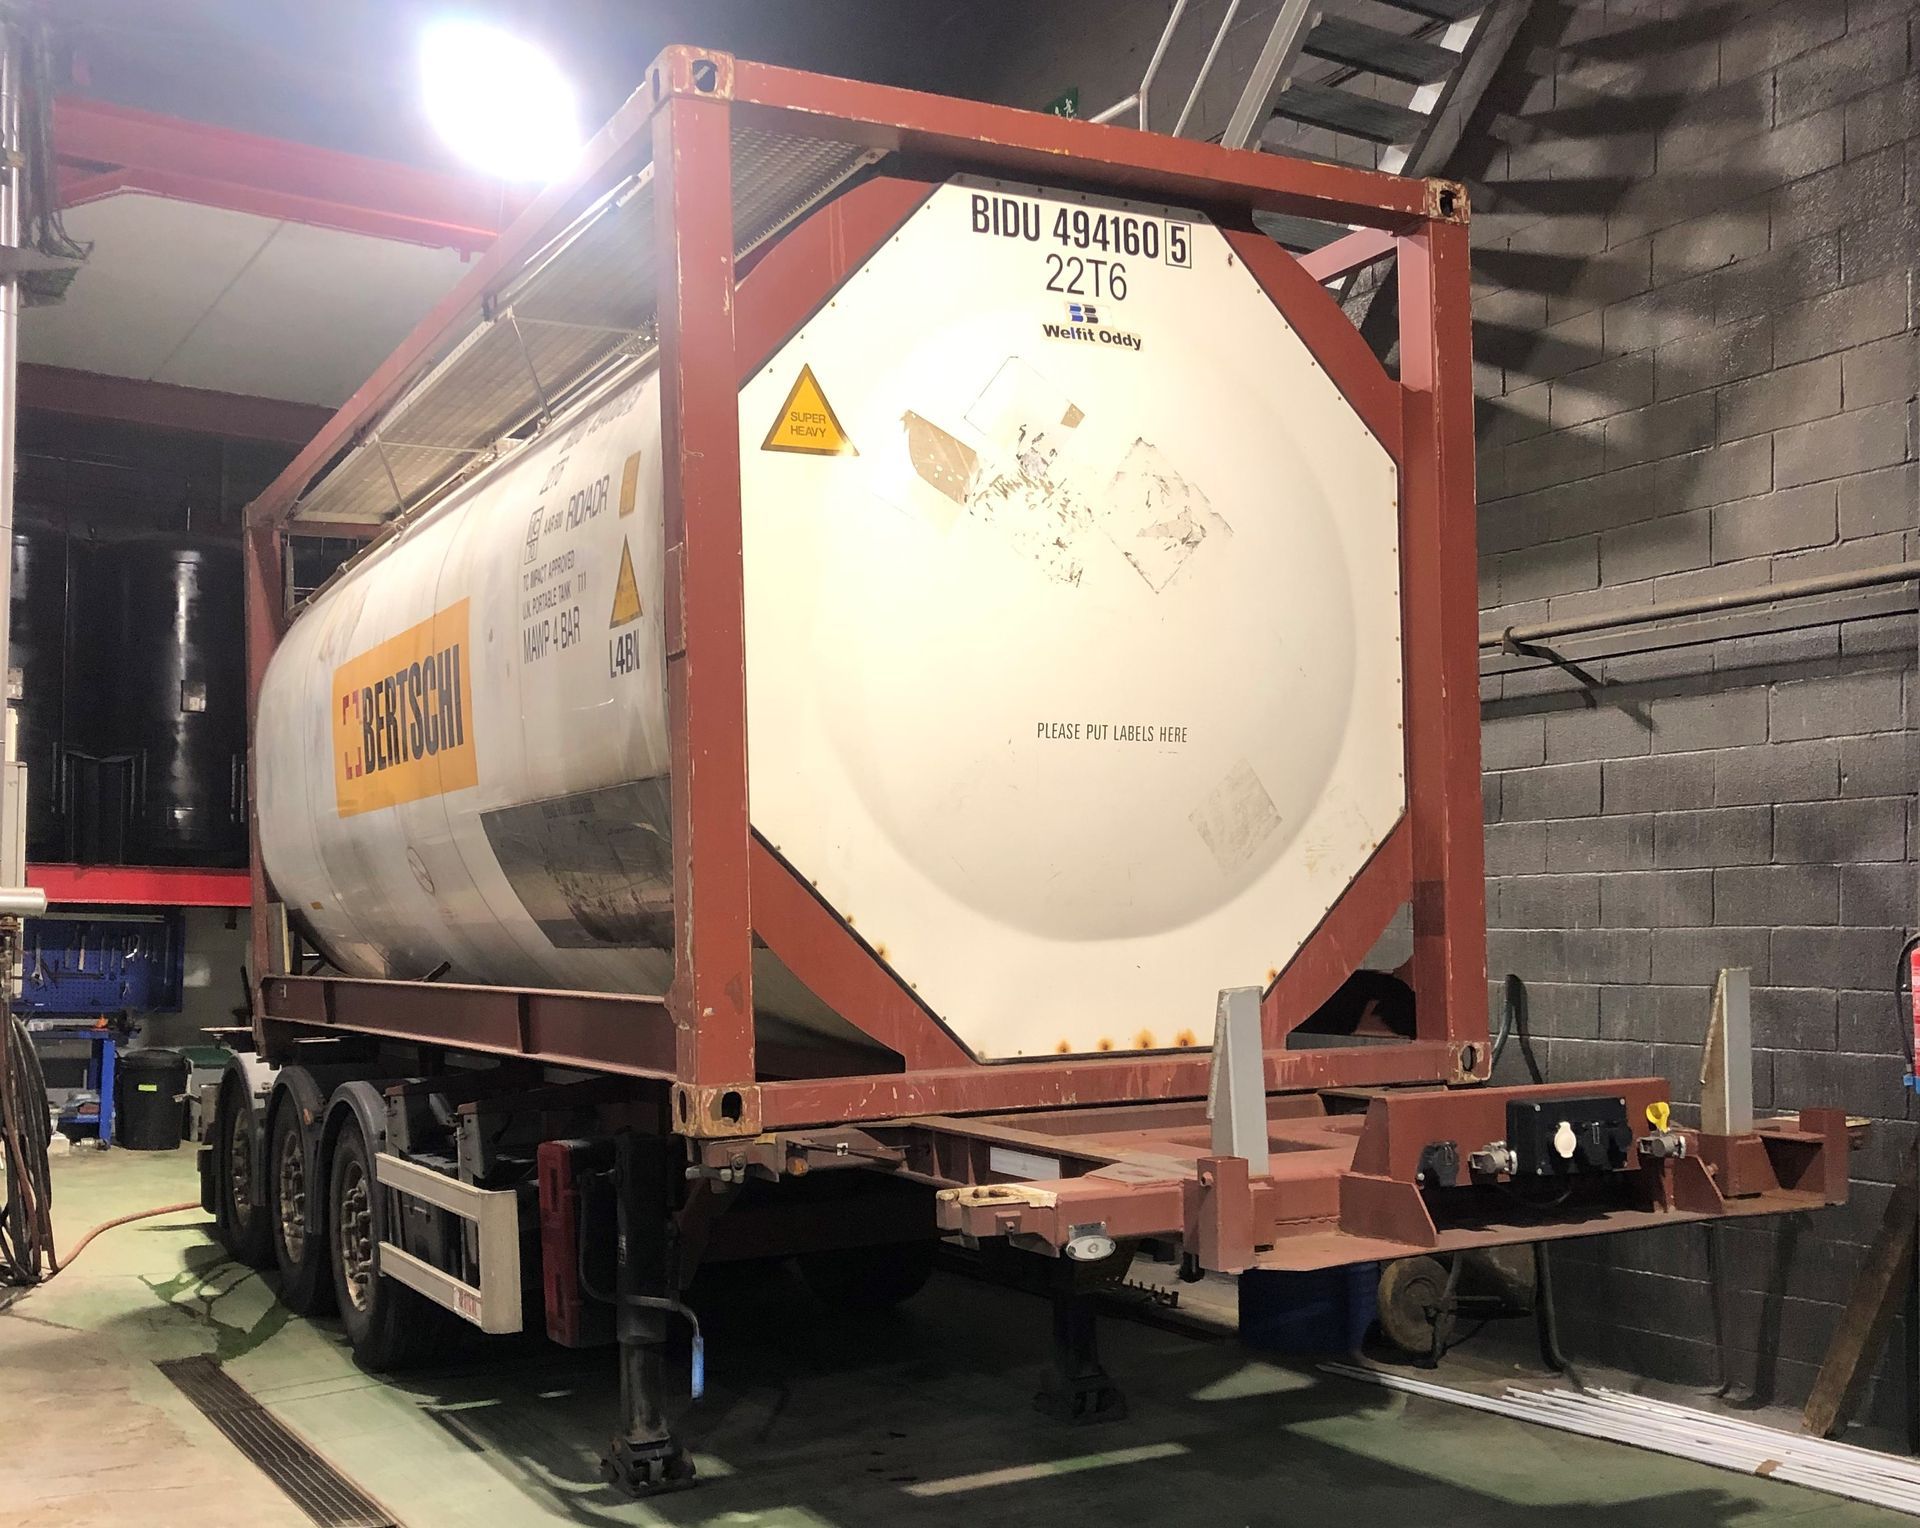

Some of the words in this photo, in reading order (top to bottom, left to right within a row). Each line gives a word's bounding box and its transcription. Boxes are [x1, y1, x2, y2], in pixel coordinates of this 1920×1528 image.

[971, 194, 1041, 242] BIDU
[1053, 207, 1159, 259] 494160
[1170, 226, 1187, 264] 5
[1045, 253, 1128, 301] 22T6
[1042, 324, 1096, 342] Welfit
[1099, 330, 1142, 351] Oddy
[790, 411, 827, 424] SUPER
[790, 424, 827, 438] HEAVY
[565, 474, 610, 532] RID/ADR
[530, 563, 548, 588] IMPACT
[548, 550, 575, 578] APPROVED
[532, 588, 557, 616] PORTABLE
[558, 580, 572, 604] TANK
[523, 619, 550, 665] MAWP
[553, 615, 559, 652] 4
[561, 606, 581, 649] BAR
[609, 628, 640, 679] L4BN
[361, 643, 464, 775] BERTSCHI
[1037, 721, 1081, 740] PLEASE
[1086, 723, 1109, 741] PUT
[1113, 724, 1155, 743] LABELS
[1159, 725, 1188, 744] HERE
